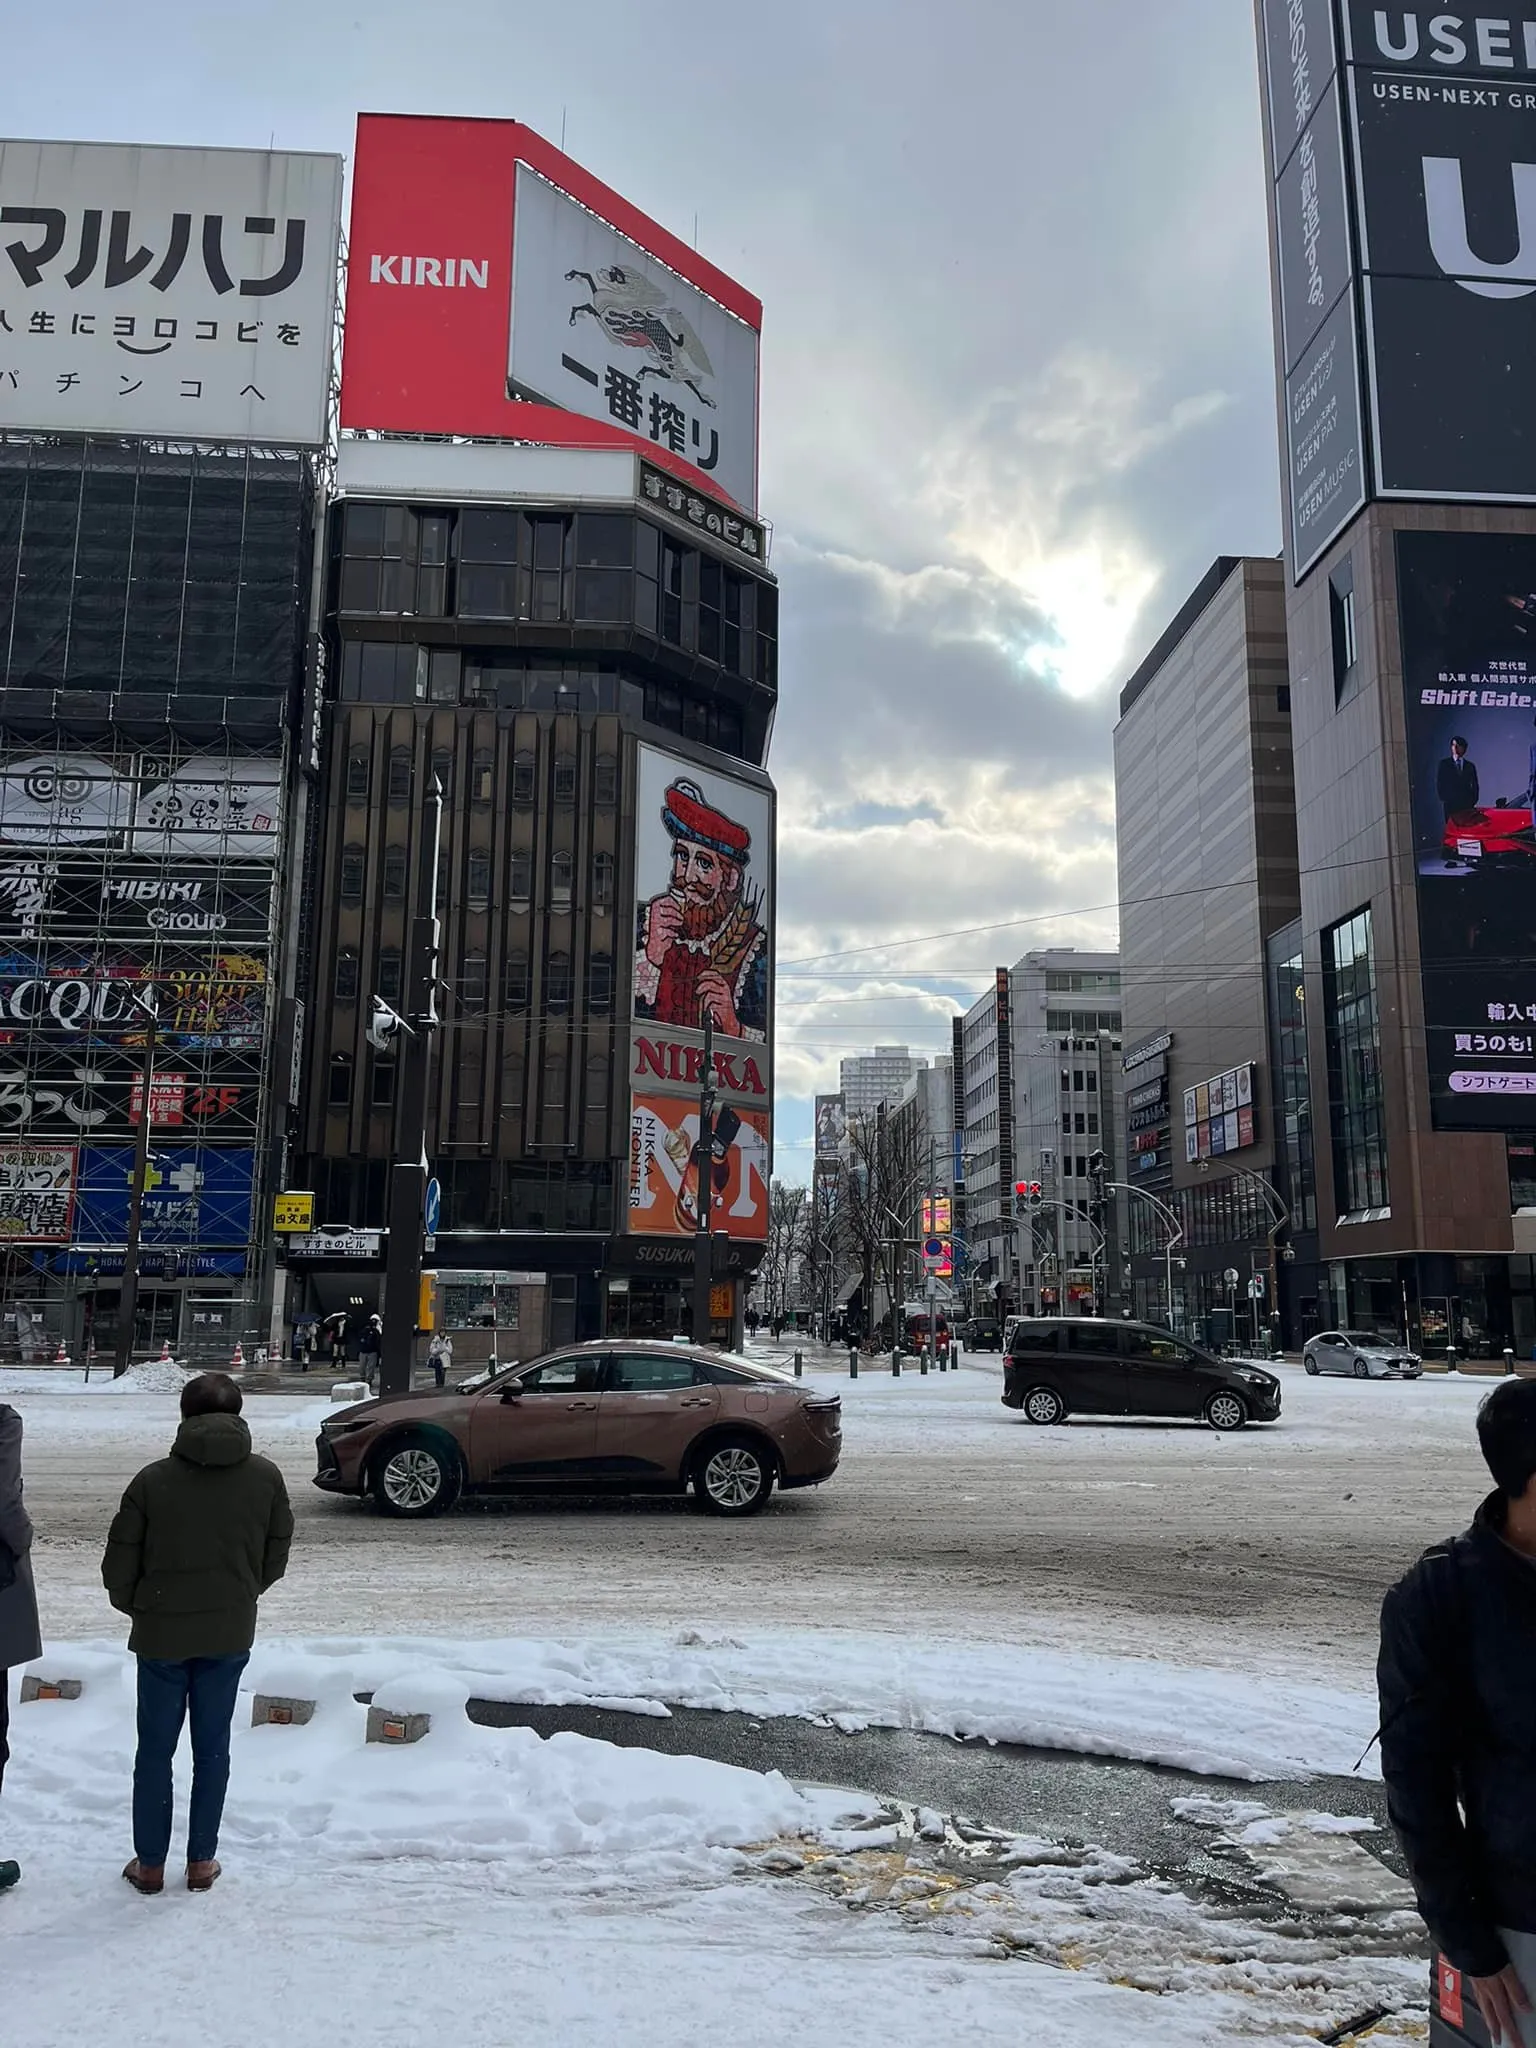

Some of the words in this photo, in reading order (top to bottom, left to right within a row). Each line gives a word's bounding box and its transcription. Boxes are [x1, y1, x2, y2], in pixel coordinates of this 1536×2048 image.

[1373, 83, 1499, 108] USEN-NEXT
[1287, 0, 1325, 306] 店の未来を創造する。
[0, 207, 306, 296] マルハン
[369, 254, 488, 289] KIRIN
[561, 353, 719, 470] 一番搾り
[1294, 385, 1319, 424] USEN
[1296, 435, 1320, 476] USEN
[1320, 411, 1339, 445] PAY
[1299, 489, 1324, 528] USEN
[1323, 448, 1355, 499] MUSIC
[644, 473, 758, 553] すすきのビル
[1420, 689, 1478, 706] Shift
[103, 879, 202, 901] HIBIKI
[147, 907, 227, 931] Group
[0, 979, 159, 1030] CQUA
[633, 1036, 767, 1094] NIKKA
[1462, 1075, 1534, 1089] シフトゲート
[192, 1086, 241, 1113] 2F
[0, 1151, 53, 1167] の聖地
[629, 1115, 643, 1208] FRONTIER
[644, 1116, 656, 1177] NIKKA
[126, 1201, 199, 1218] ツドラ
[303, 1240, 365, 1249] すすきのビル
[636, 1246, 695, 1263] SUSUKIN
